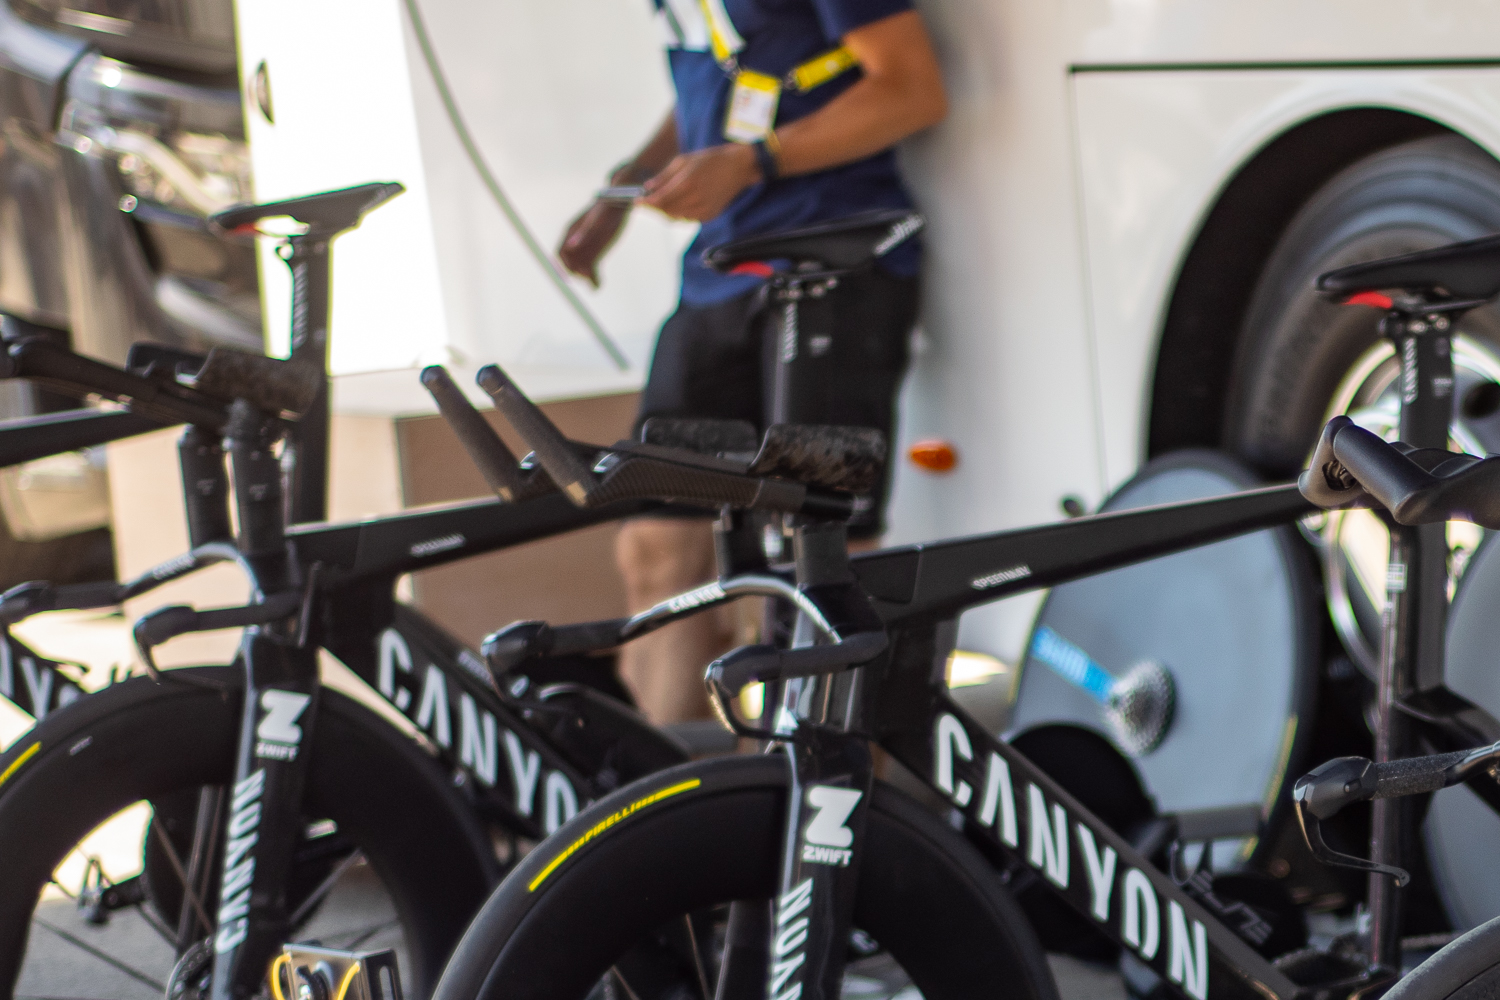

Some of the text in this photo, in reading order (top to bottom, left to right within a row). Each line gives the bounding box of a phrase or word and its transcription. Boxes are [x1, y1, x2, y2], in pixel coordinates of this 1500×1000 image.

[378, 627, 580, 836] CANYO
[215, 767, 267, 954] CANYON
[584, 803, 637, 843] PIRELLI
[802, 845, 853, 867] ZWIFT
